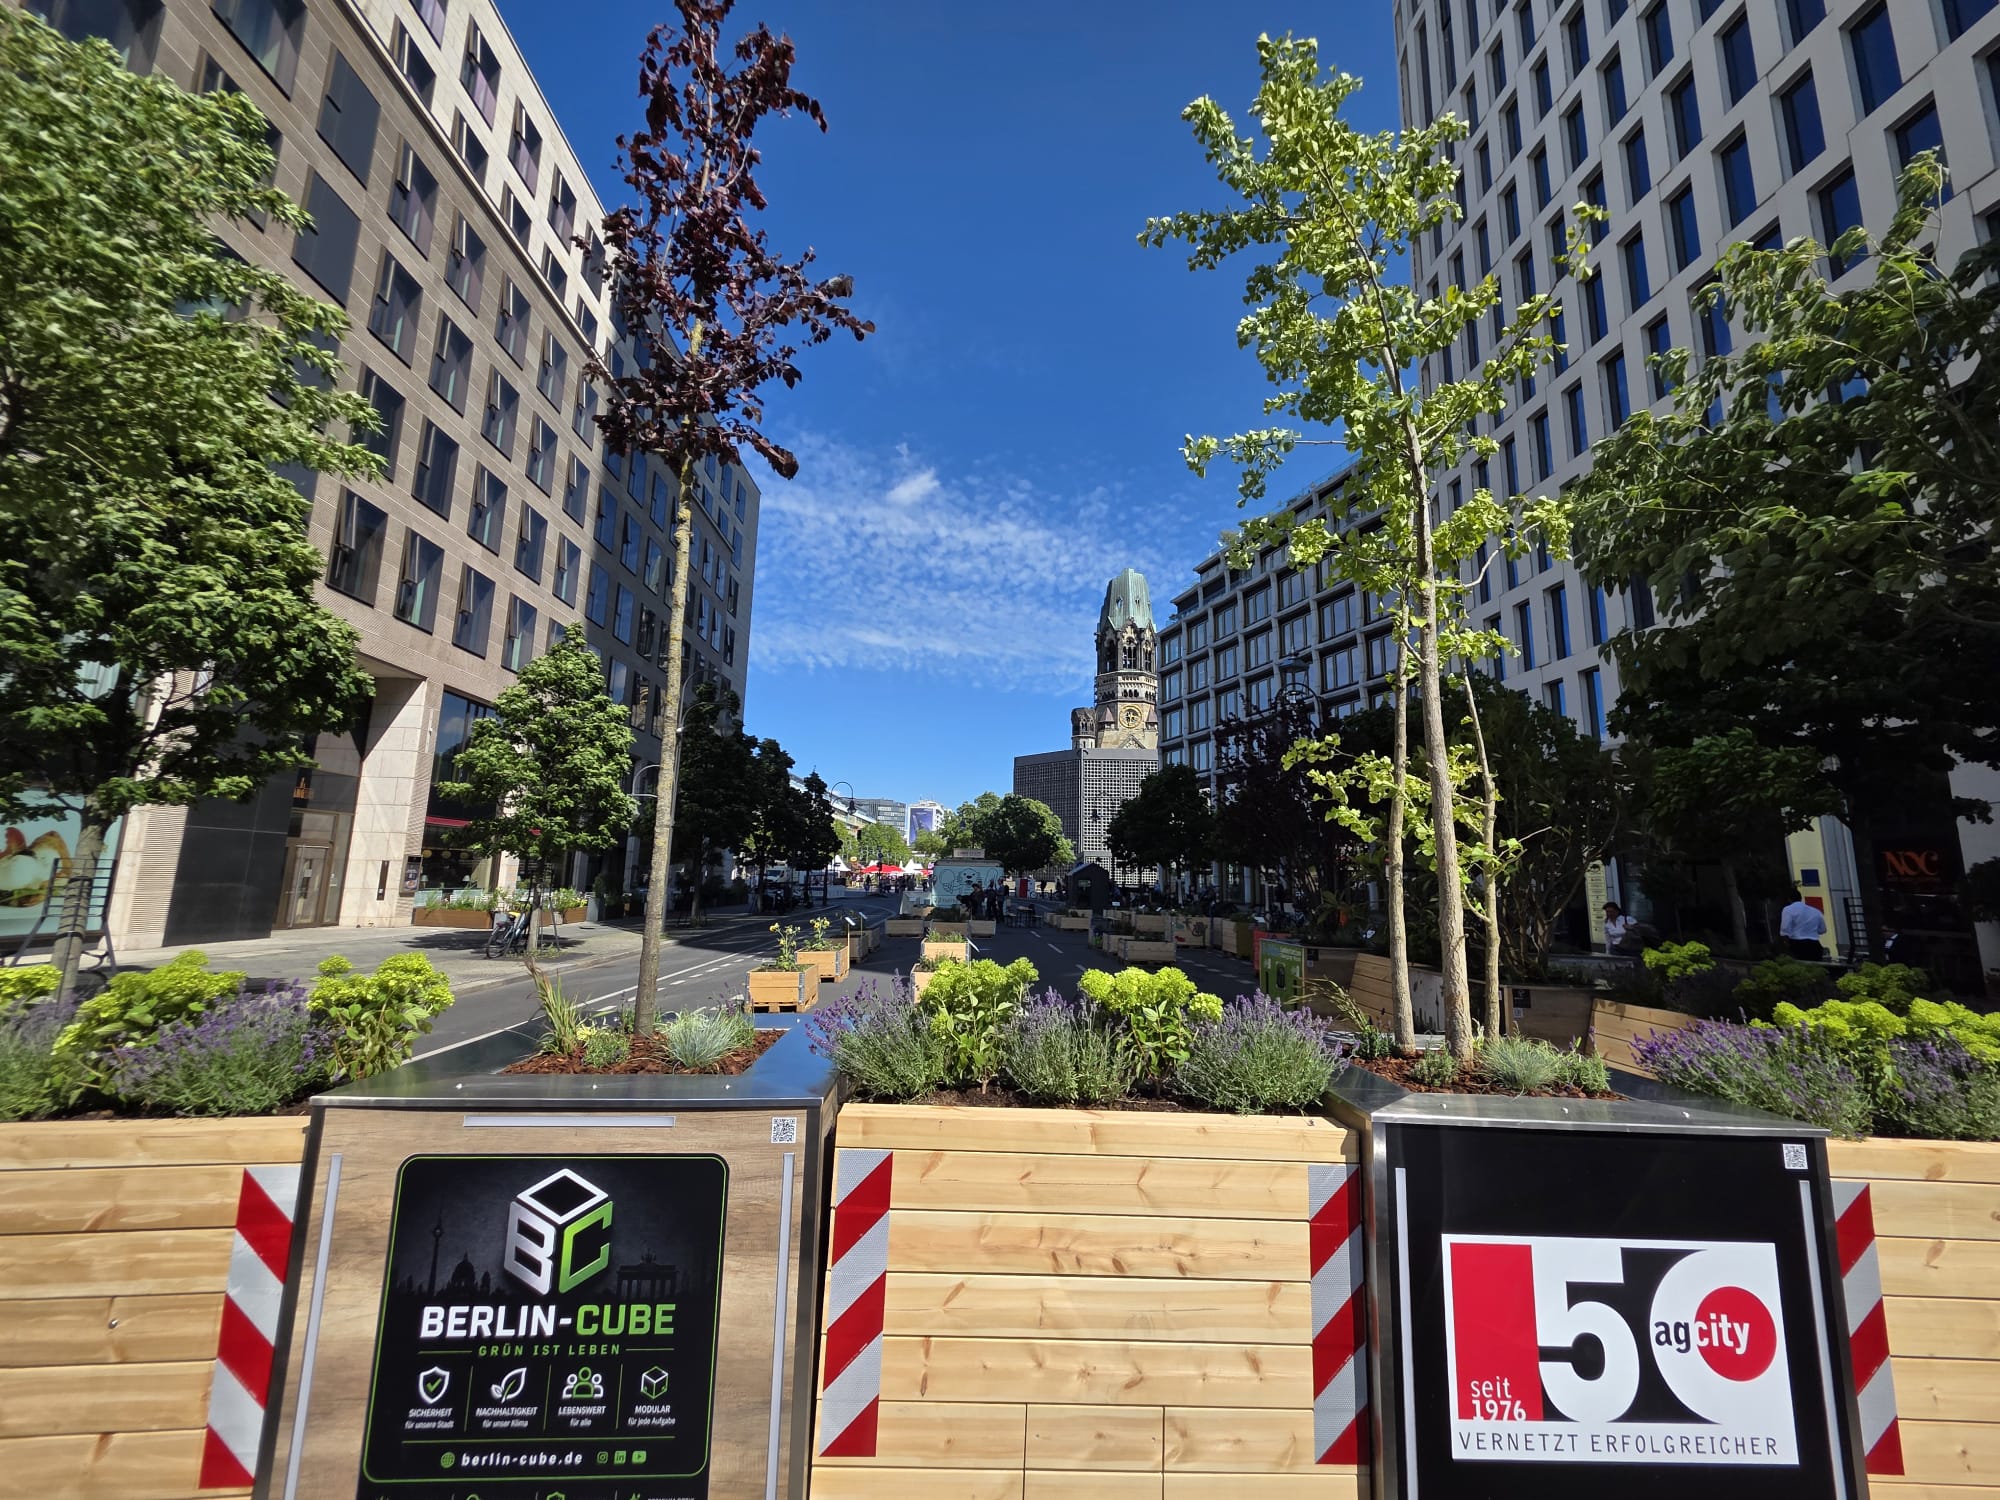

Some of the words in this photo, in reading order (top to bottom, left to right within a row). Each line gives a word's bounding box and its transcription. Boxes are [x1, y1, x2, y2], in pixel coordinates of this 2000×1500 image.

[419, 1303, 676, 1338] BERLIN-CUBE
[1654, 1313, 1750, 1354] agcity
[478, 1343, 524, 1357] GRÜN
[533, 1344, 561, 1356] IST
[568, 1344, 621, 1356] LEBEN
[1470, 1376, 1512, 1399] seit
[408, 1407, 453, 1418] SICHERHEIT
[475, 1406, 538, 1417] NACHHALTIGKEIT
[557, 1405, 607, 1416] LEBENSWERT
[634, 1404, 671, 1414] MODULAR
[1471, 1399, 1527, 1421] 1976
[404, 1420, 415, 1429] für
[482, 1419, 492, 1428] für
[492, 1419, 510, 1428] unser
[569, 1417, 579, 1427] für
[580, 1417, 592, 1427] alle
[627, 1416, 637, 1425] für
[637, 1416, 651, 1427] jede
[651, 1416, 676, 1427] Aufgabe
[1458, 1431, 1579, 1453] VERNETZT
[1591, 1433, 1778, 1456] ERFOLGREICHER
[461, 1451, 583, 1466] berlin-cube.de
